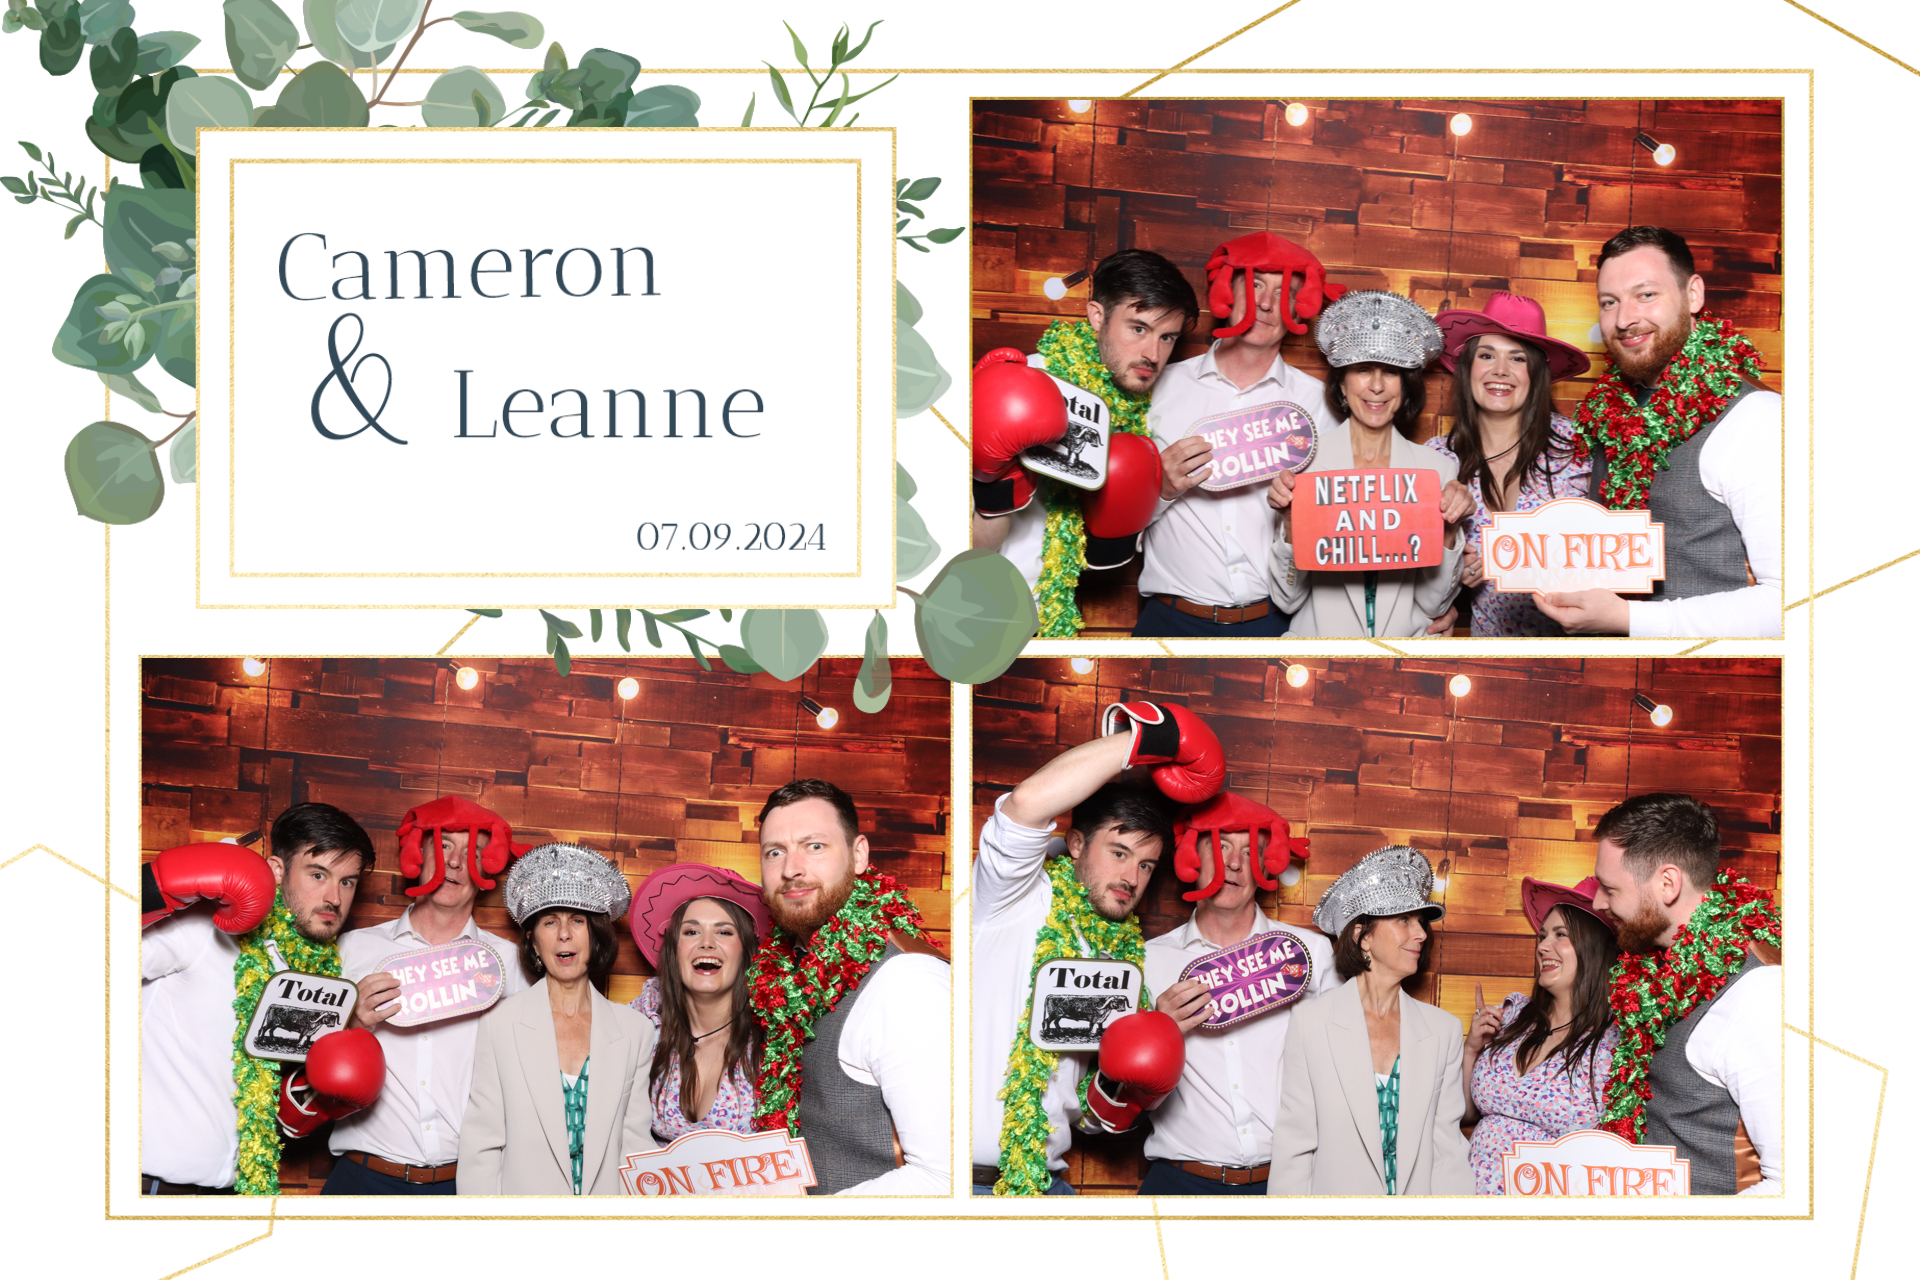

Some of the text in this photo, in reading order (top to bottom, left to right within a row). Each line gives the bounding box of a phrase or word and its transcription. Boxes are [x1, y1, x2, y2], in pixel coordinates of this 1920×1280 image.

[1063, 395, 1101, 425] tal
[1202, 411, 1301, 450] HEY SEE ME
[1205, 441, 1290, 481] ROLLIN
[1315, 473, 1418, 505] NETFLIX
[1335, 509, 1401, 532] AND
[1315, 534, 1422, 566] CHILL...?
[1492, 533, 1653, 572] ON FIRE
[388, 950, 489, 986] HEY SEE ME
[1237, 951, 1267, 978] SEE
[1269, 940, 1296, 965] ME
[278, 978, 349, 1008] Total
[1050, 967, 1130, 990] Total
[1204, 971, 1287, 1021] ROLLIN
[393, 979, 478, 1017] ROLLIN
[636, 1149, 802, 1195] ON FIRE
[1514, 1162, 1676, 1195] ON FIRE
